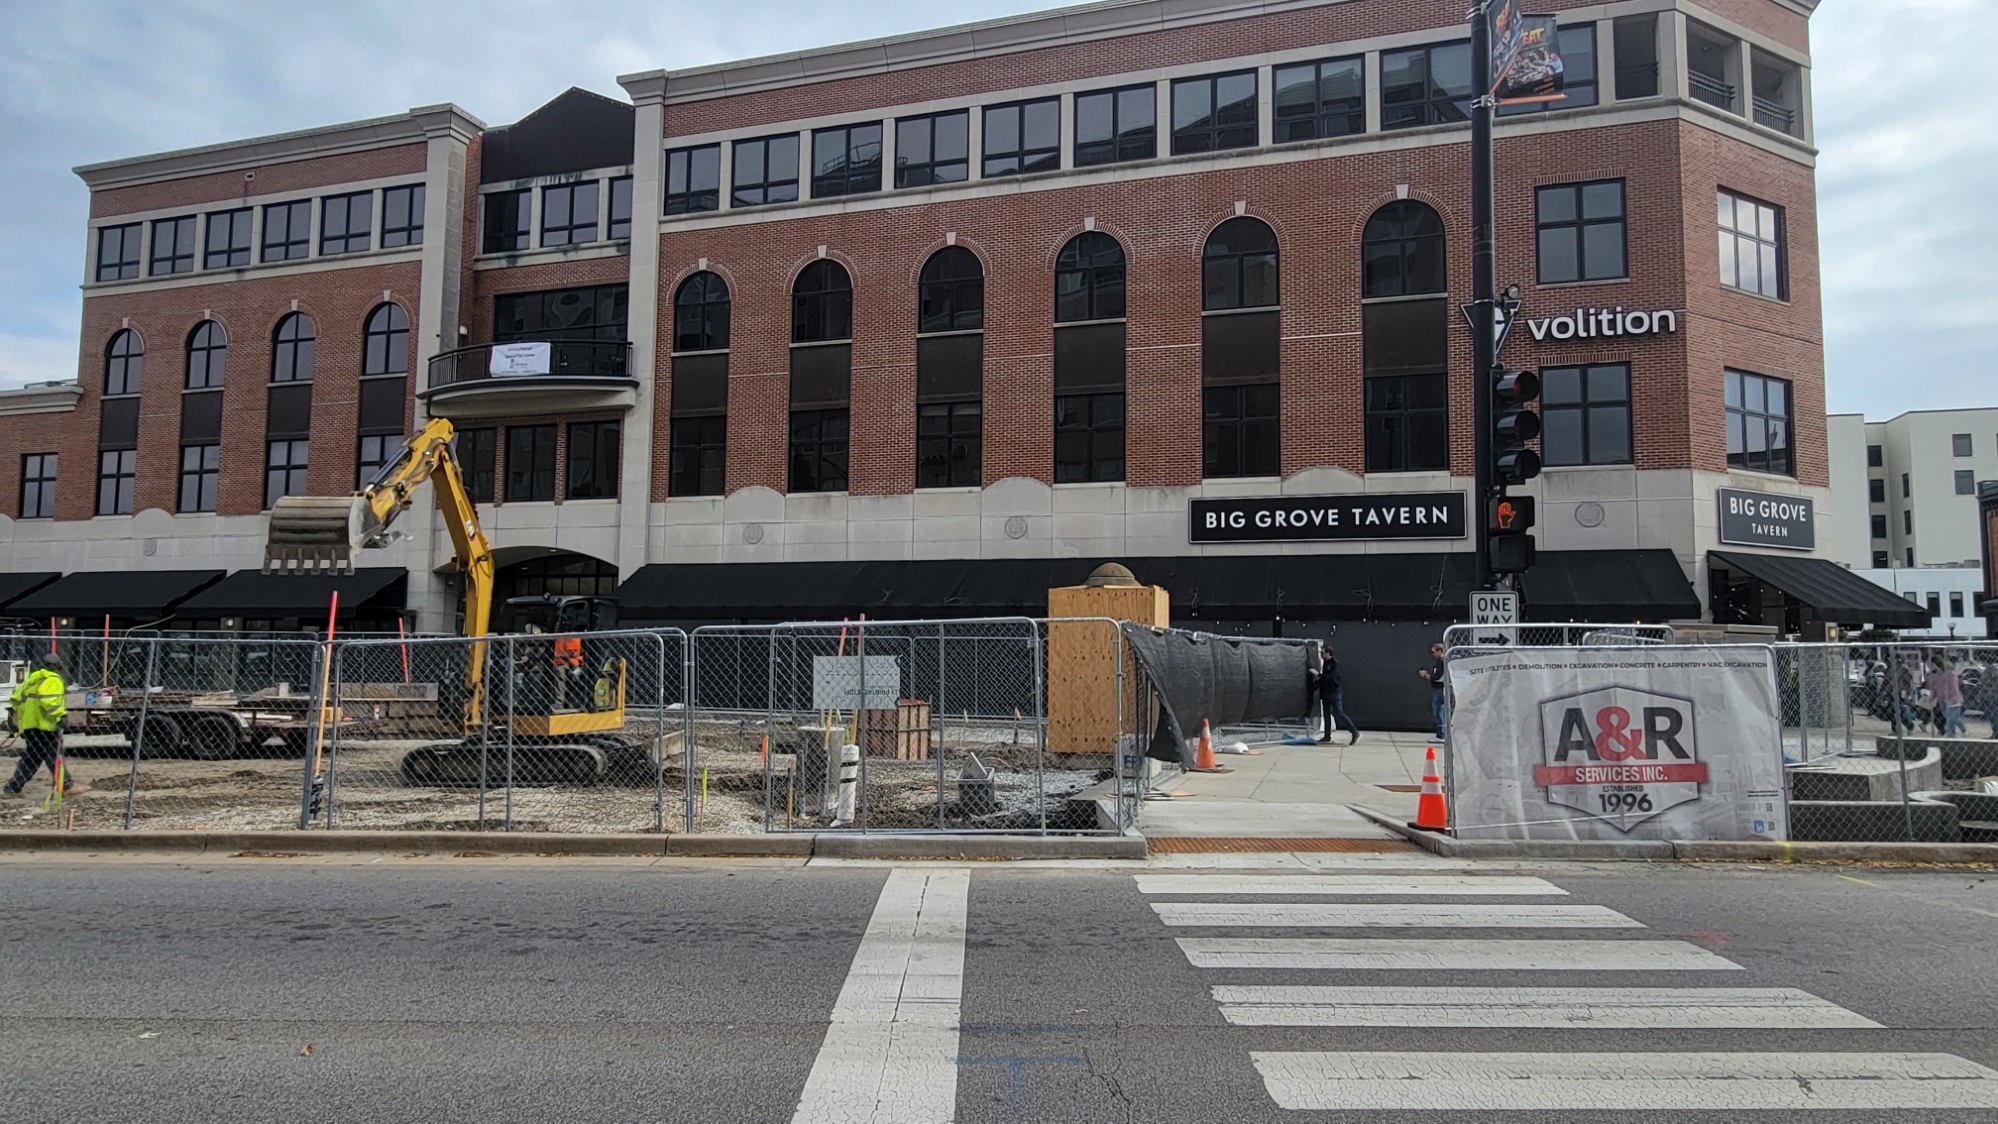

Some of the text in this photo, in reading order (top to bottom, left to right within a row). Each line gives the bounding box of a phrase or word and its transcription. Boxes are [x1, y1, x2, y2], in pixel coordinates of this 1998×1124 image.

[1522, 28, 1544, 45] EAT
[1526, 306, 1676, 341] volition
[1205, 506, 1449, 529] BIG GROVE TAVERN
[1730, 497, 1807, 522] BIG GROVE
[1751, 523, 1788, 538] TAVERN
[1477, 597, 1511, 612] ONE
[1477, 614, 1512, 624] WAY
[1469, 667, 1485, 676] SITE
[1662, 661, 1702, 669] CARPENTRY
[1723, 661, 1768, 669] EXCAVATION
[1554, 706, 1691, 762] A&R
[1575, 766, 1668, 783] SERVICES INC.
[1598, 793, 1653, 813] 1996
